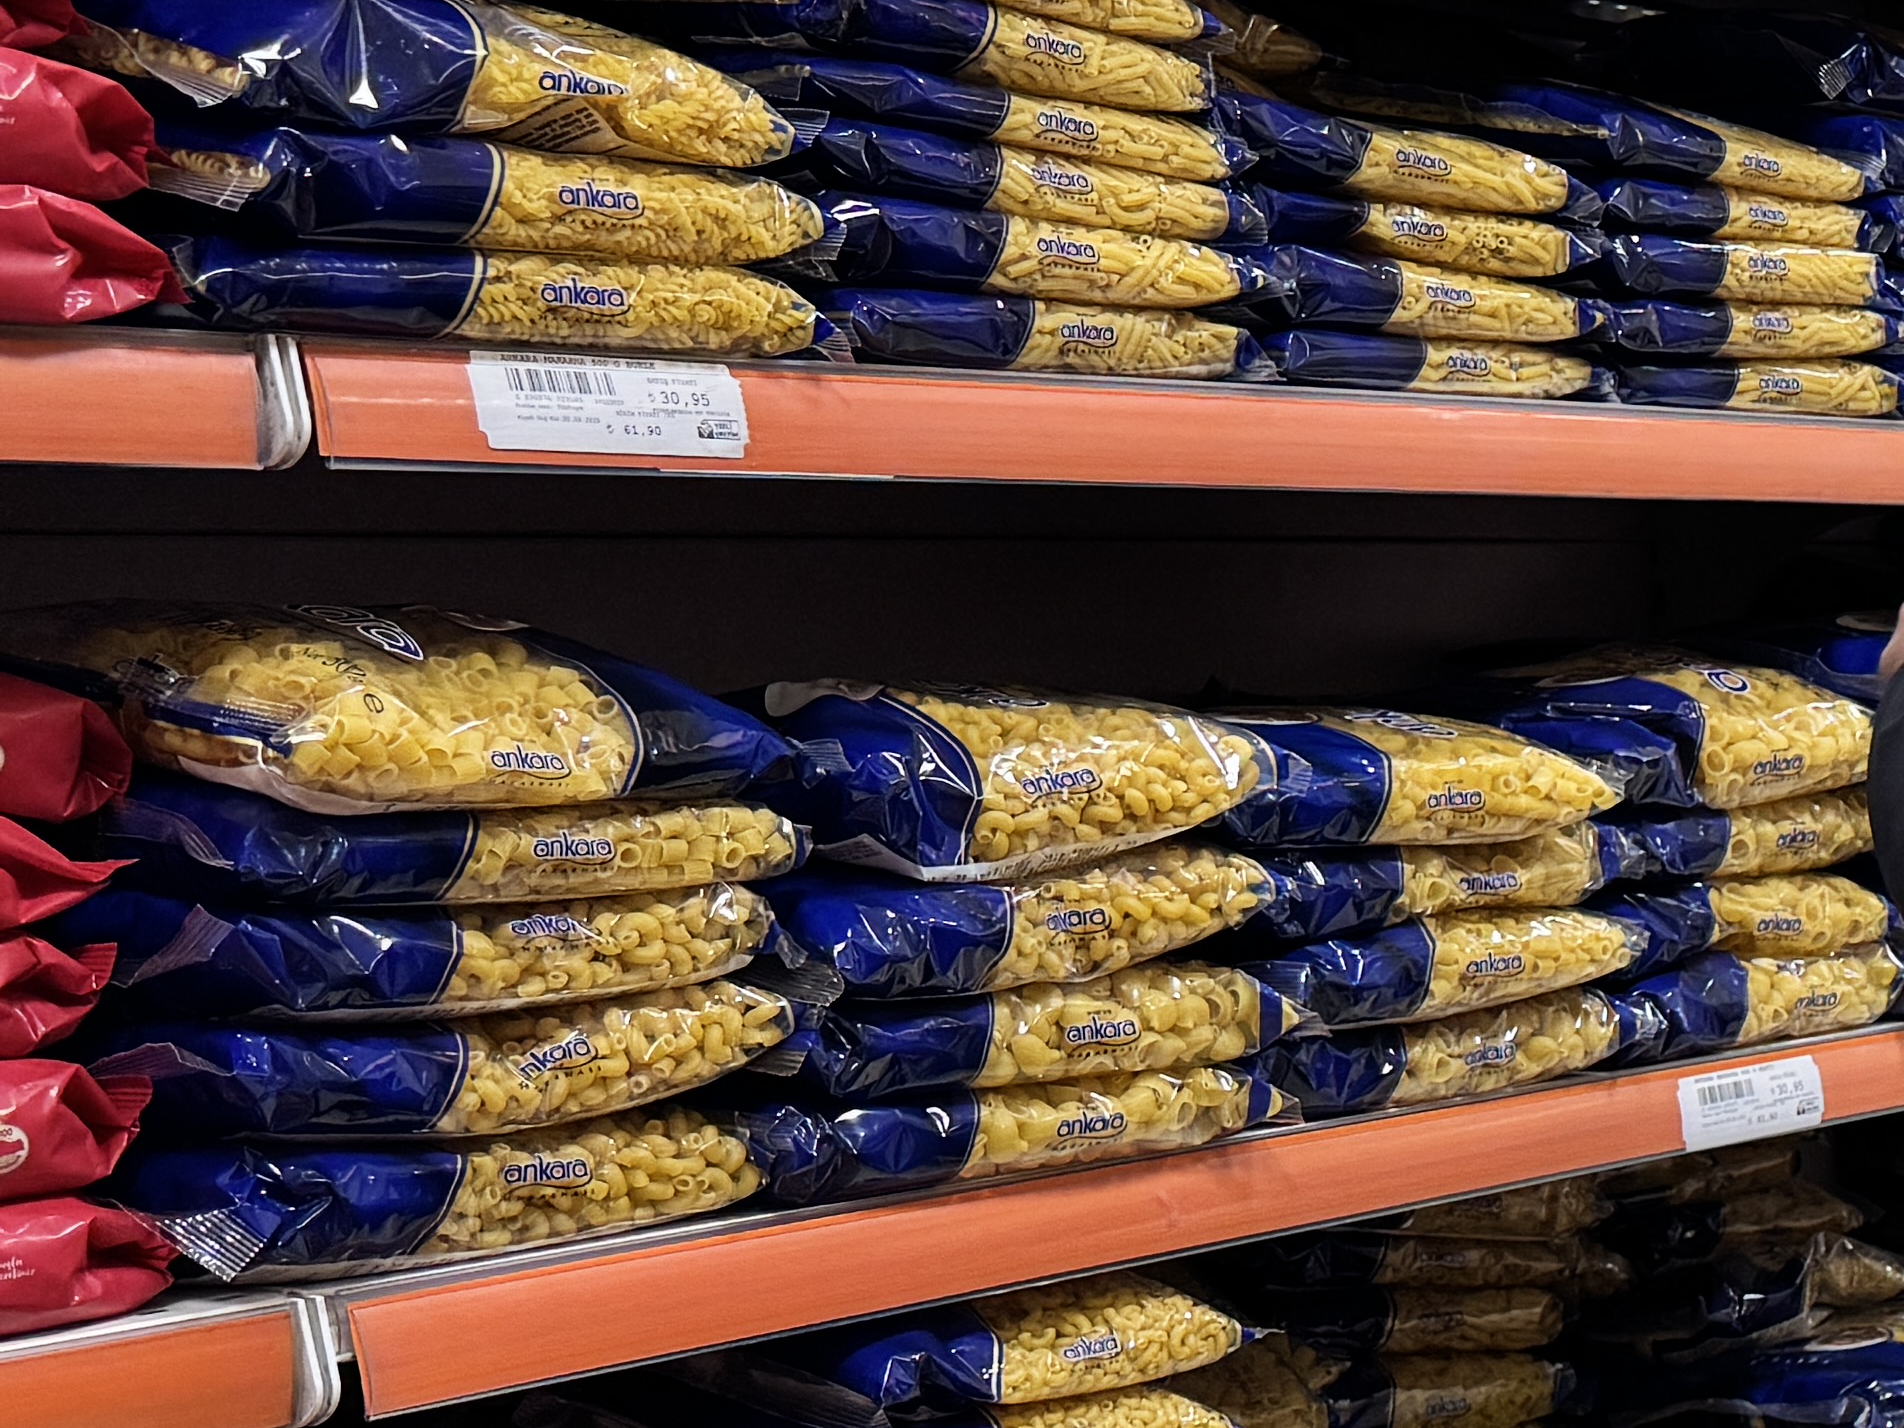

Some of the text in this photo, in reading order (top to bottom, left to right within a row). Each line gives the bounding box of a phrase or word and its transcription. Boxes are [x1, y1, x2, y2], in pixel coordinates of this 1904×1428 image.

[1025, 33, 1083, 59] ankara
[1037, 109, 1096, 136] ankara
[1396, 147, 1449, 172] ankara
[558, 182, 641, 211] ankara
[1391, 216, 1447, 240] ankara
[1037, 234, 1096, 261] ankara
[541, 277, 627, 308] ankara
[1426, 282, 1474, 305] ankara
[1060, 321, 1115, 344] ankara
[1446, 353, 1489, 373] ankara
[490, 743, 565, 772] ankara
[1753, 753, 1805, 776] ankara
[1021, 767, 1097, 796] ankara
[1427, 785, 1483, 811] ankara
[533, 832, 614, 859] ankara
[1459, 871, 1520, 893] ankara
[1757, 916, 1802, 934] ankara
[1466, 951, 1524, 976] ankara
[1066, 1014, 1138, 1044] ankara
[519, 1034, 593, 1078] nkara
[1057, 1110, 1126, 1139] ankara
[503, 1153, 590, 1185] ankara
[1064, 1333, 1119, 1362] ankara
